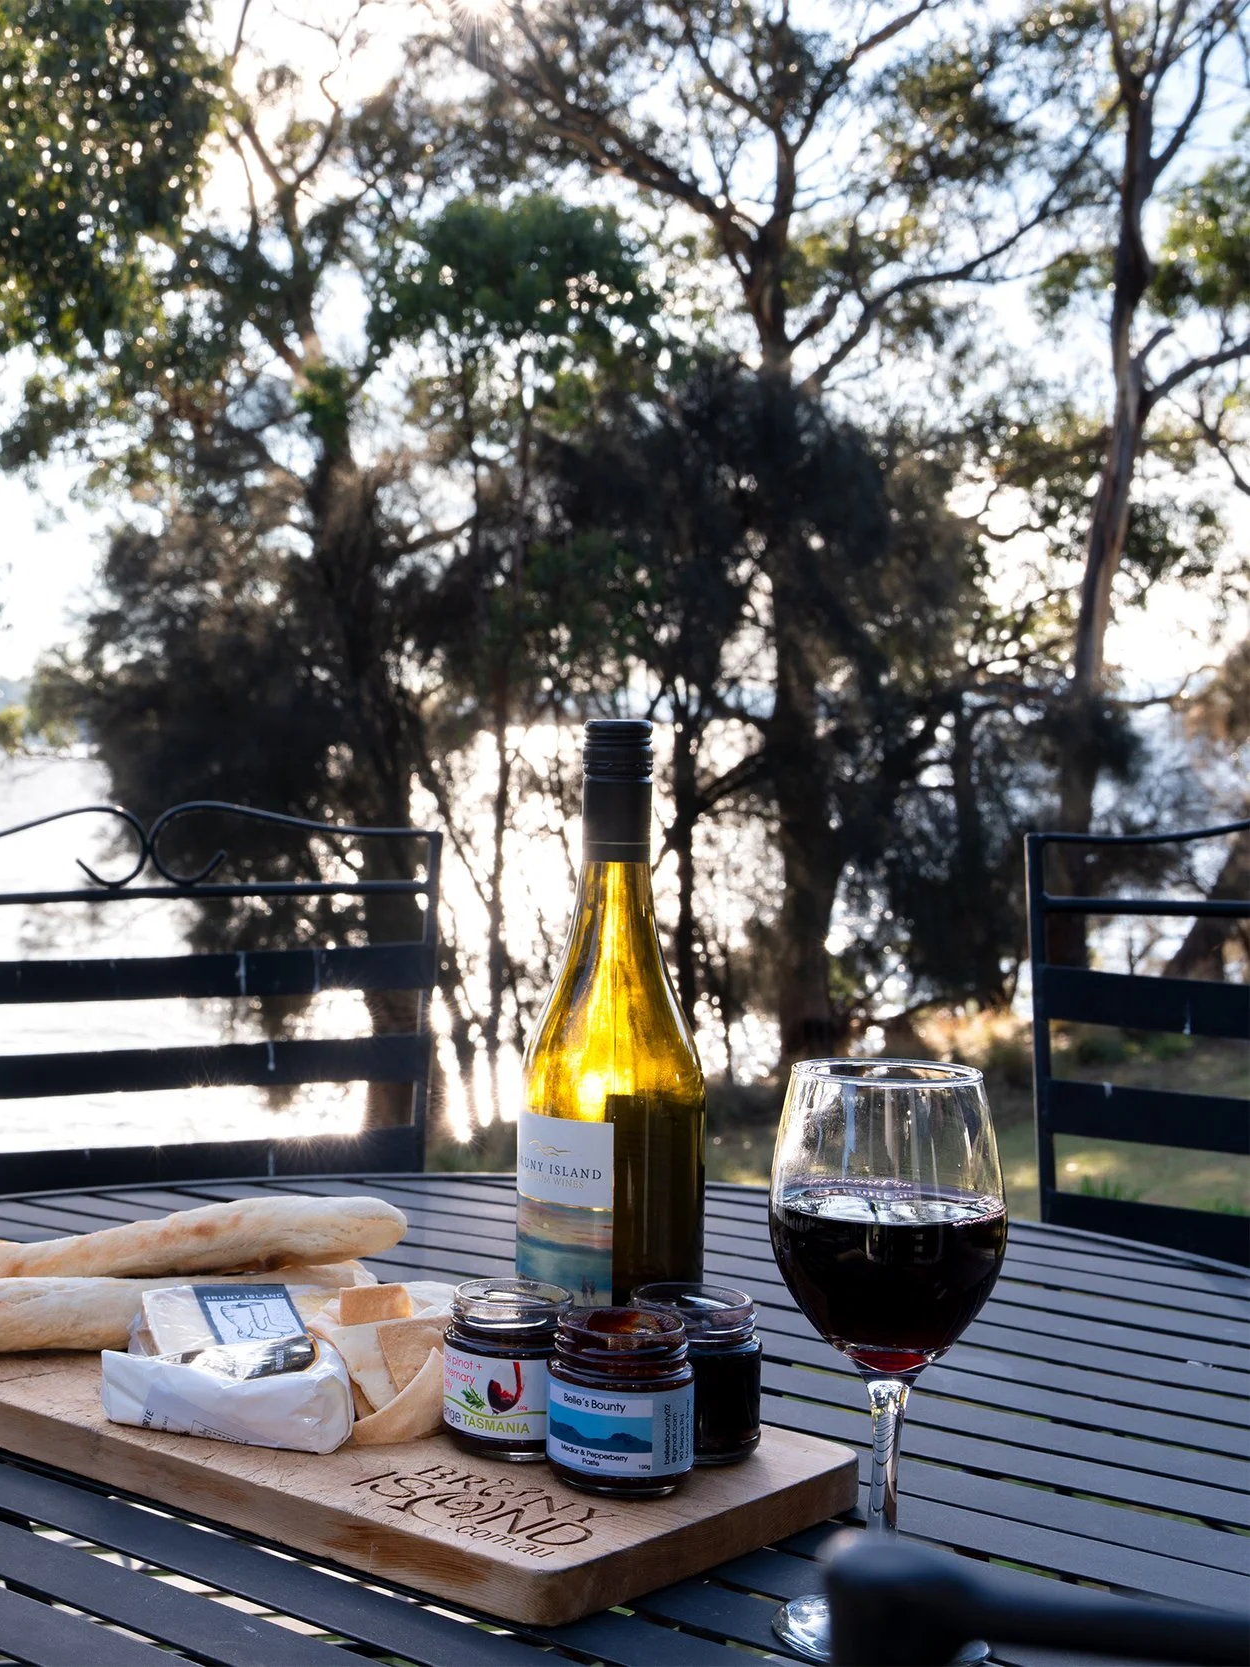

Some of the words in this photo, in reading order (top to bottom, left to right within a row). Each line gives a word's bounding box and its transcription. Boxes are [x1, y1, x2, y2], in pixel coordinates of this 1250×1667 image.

[549, 1164, 602, 1180] ISLAND
[553, 1177, 584, 1190] WINES
[452, 1355, 473, 1371] pinot
[563, 1392, 589, 1408] Belle's
[591, 1399, 626, 1414] Bounty
[462, 1413, 530, 1434] TASMANIA
[561, 1442, 579, 1455] Medlar
[586, 1450, 629, 1463] Pepperberry
[581, 1457, 600, 1467] Paste
[447, 1524, 554, 1558] .com.au
